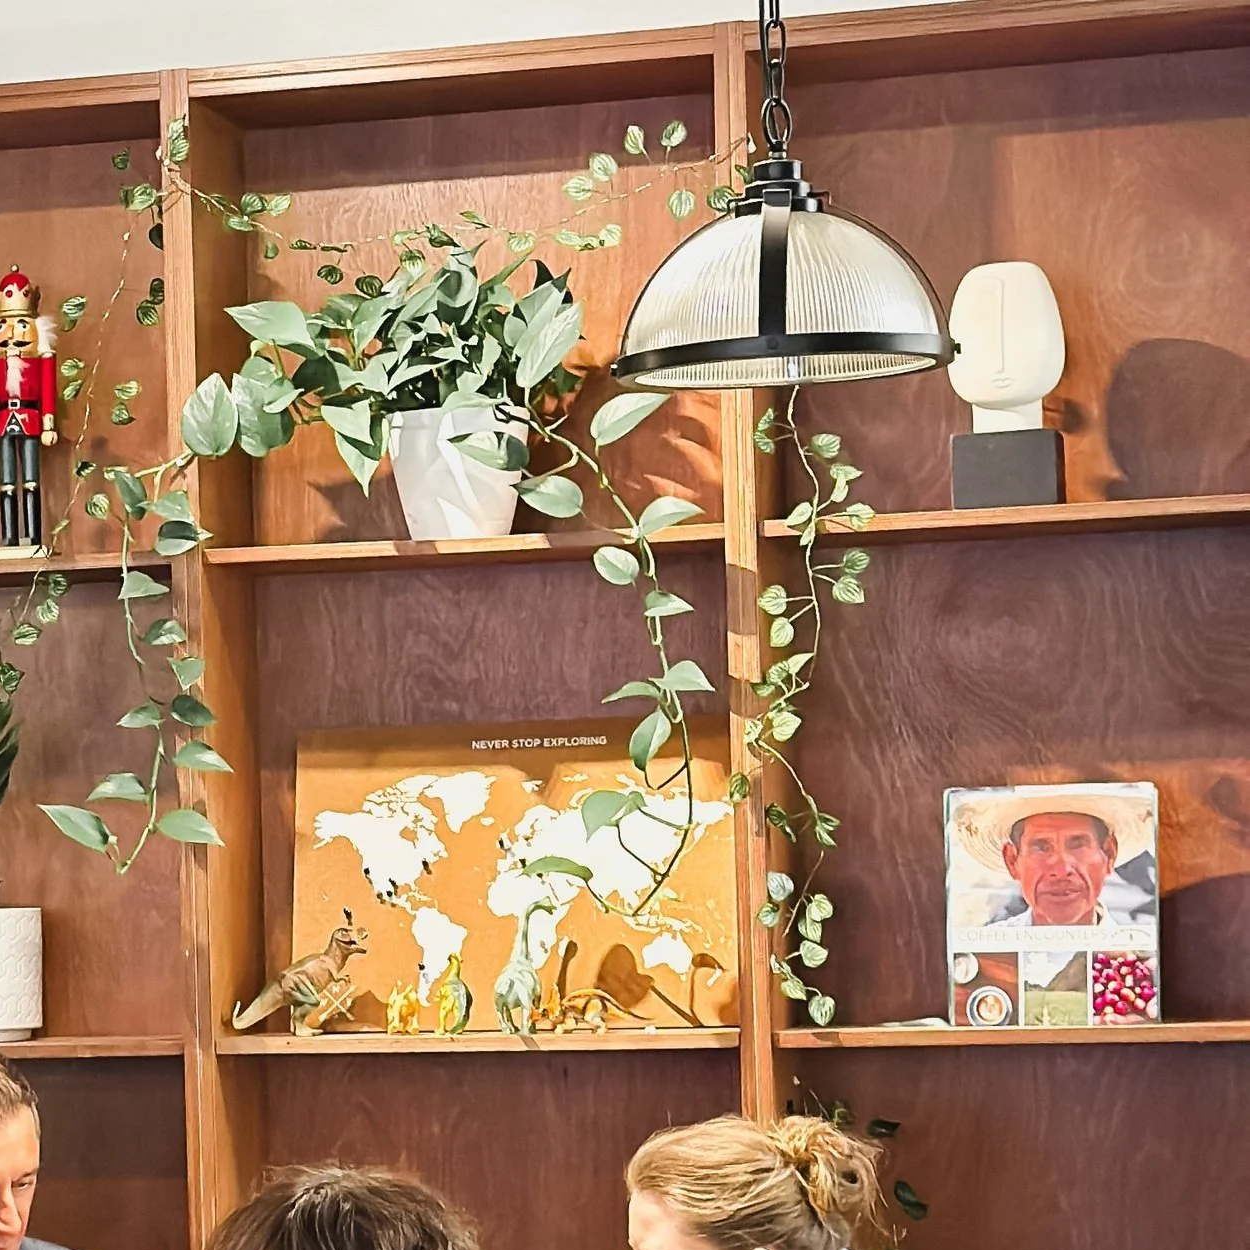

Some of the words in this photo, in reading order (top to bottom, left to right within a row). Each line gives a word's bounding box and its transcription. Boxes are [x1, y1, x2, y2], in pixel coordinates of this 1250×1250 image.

[471, 740, 509, 749] NEVER
[511, 738, 541, 748] STOP
[543, 736, 608, 747] EXPLORING
[957, 929, 1009, 941] COFFEE
